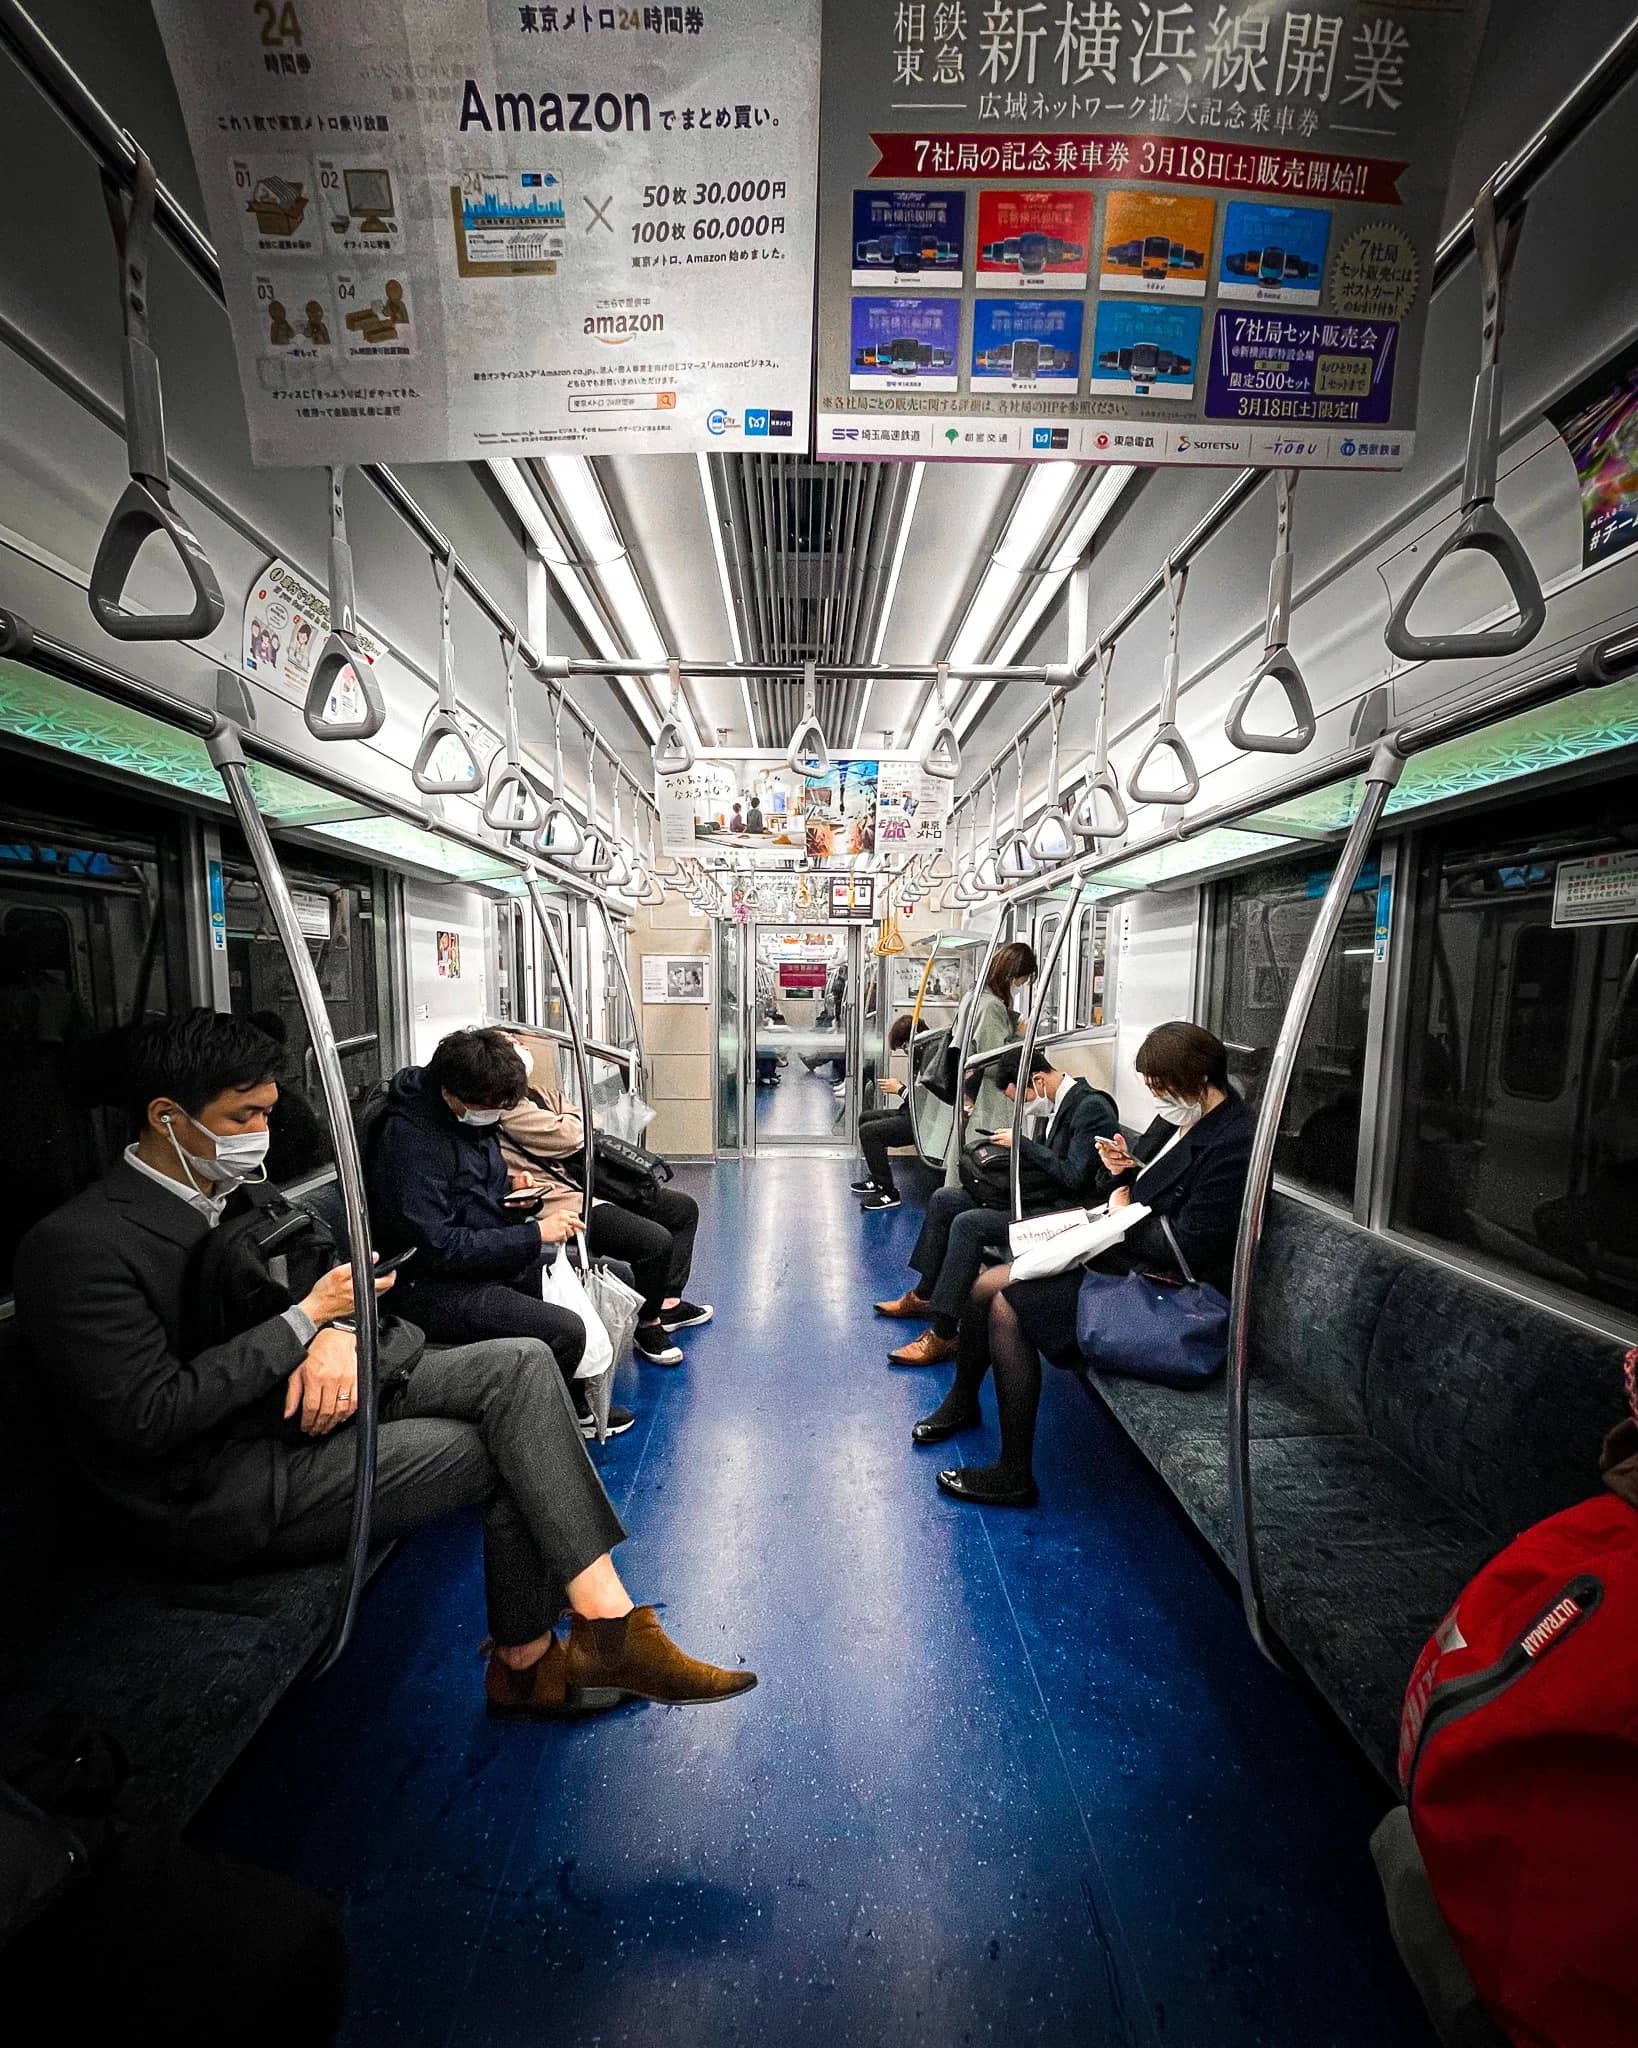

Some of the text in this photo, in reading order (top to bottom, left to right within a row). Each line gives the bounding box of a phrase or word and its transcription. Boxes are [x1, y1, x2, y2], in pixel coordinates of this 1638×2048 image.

[253, 1, 303, 47] 24
[518, 5, 704, 35] 東京メトロ24時間券
[892, 2, 968, 44] 相鉄
[892, 46, 967, 87] 東急
[978, 0, 1410, 111] 新横浜線開業
[977, 91, 1321, 137] 広域ネットワーク拡大記念乗車券
[912, 139, 1131, 174] 7社局の記念乗車券
[235, 170, 251, 188] 01
[319, 170, 340, 189] 02
[642, 179, 787, 208] 50枚 30,000円
[631, 214, 786, 245] 100枚 60,000円
[257, 284, 275, 300] 03
[338, 284, 356, 300] 04
[583, 312, 664, 335] amazon
[1234, 316, 1379, 351] 7社局セット販売会
[1229, 372, 1312, 391] 限定500セット
[860, 428, 921, 442] 埼玉高速鉄道
[963, 432, 1009, 444] 都営交通
[1193, 440, 1240, 451] SOTETSU
[1273, 440, 1318, 455] TOBU
[916, 830, 942, 839] メトロ
[921, 820, 940, 830] 東京
[1520, 1597, 1579, 1658] ULTRAMAN
